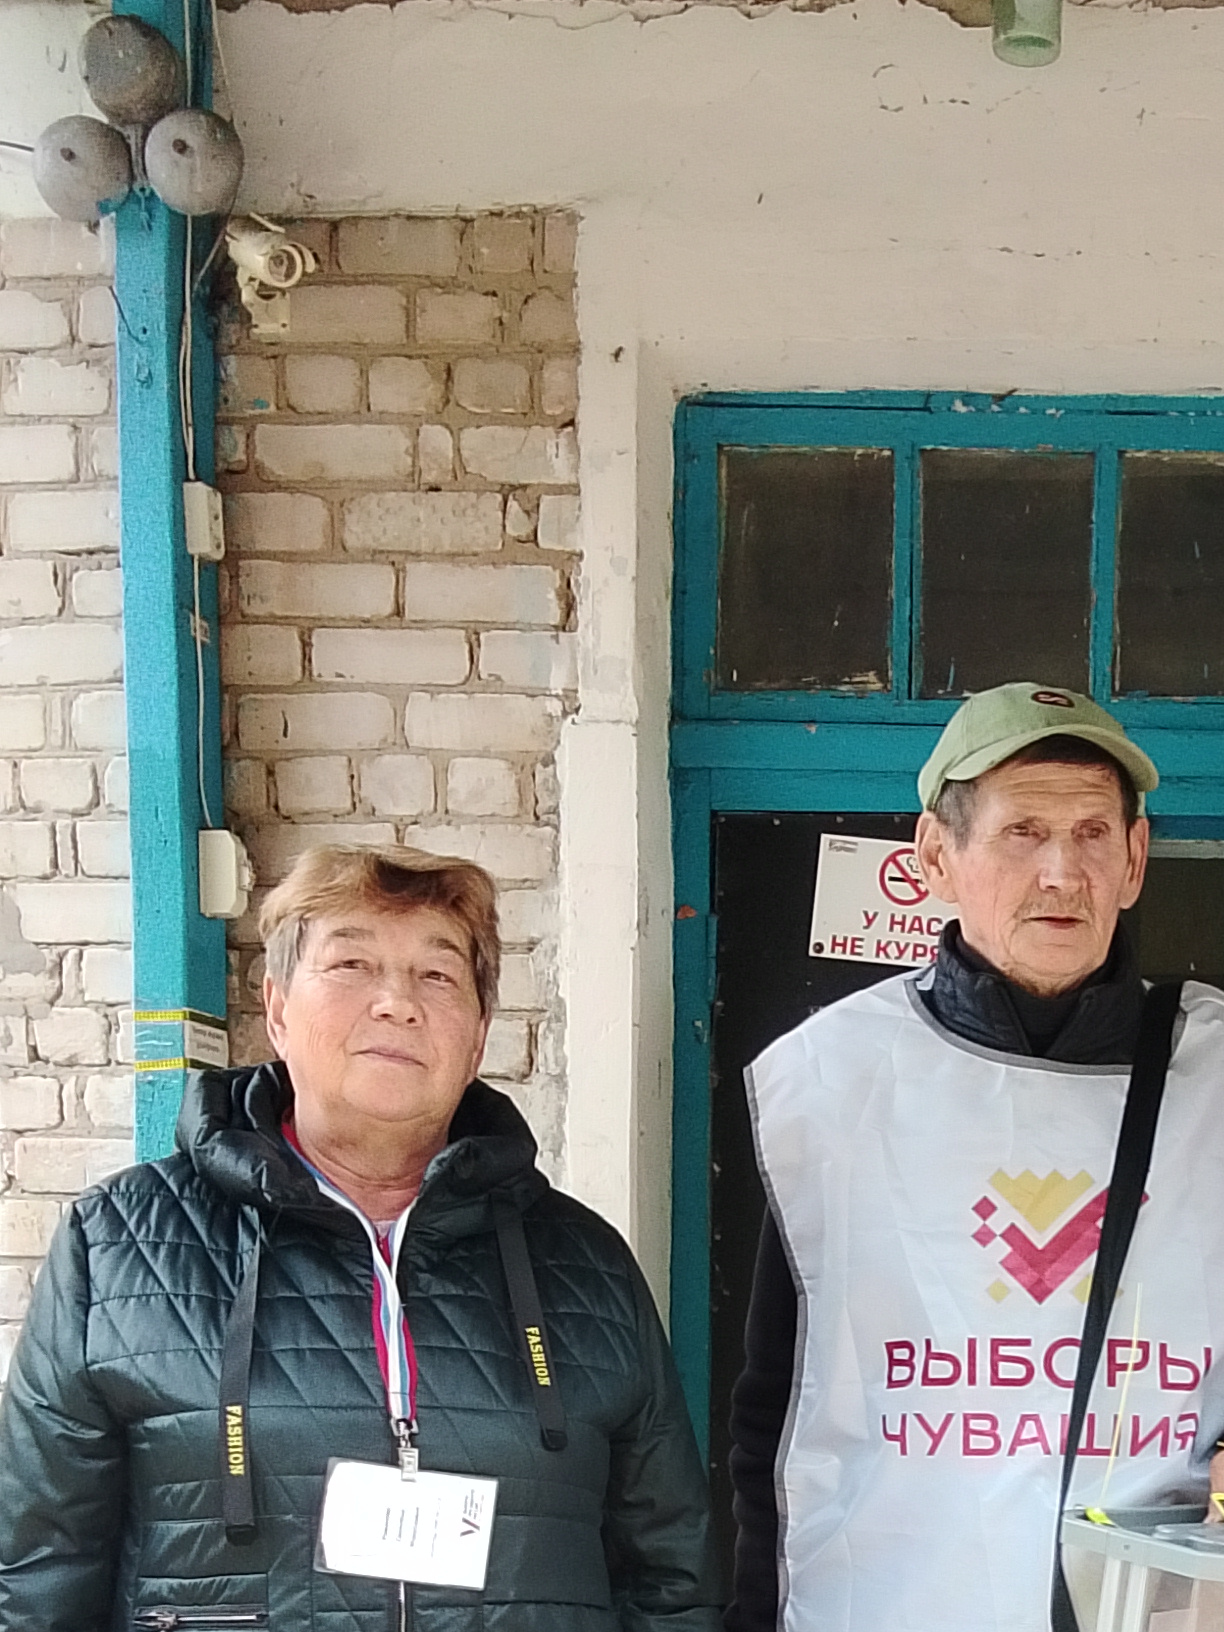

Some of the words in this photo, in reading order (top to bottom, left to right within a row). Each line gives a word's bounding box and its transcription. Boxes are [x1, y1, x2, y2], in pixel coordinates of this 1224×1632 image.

[830, 934, 865, 957] НЕ
[875, 939, 939, 963] КУРЯ
[862, 910, 879, 930] У
[889, 913, 943, 937] НАС
[525, 1327, 551, 1386] FASHION
[884, 1337, 1213, 1392] ВЫБОРЫ
[226, 1405, 245, 1475] FASHION
[881, 1412, 1200, 1458] ЧУВАШИЯ
